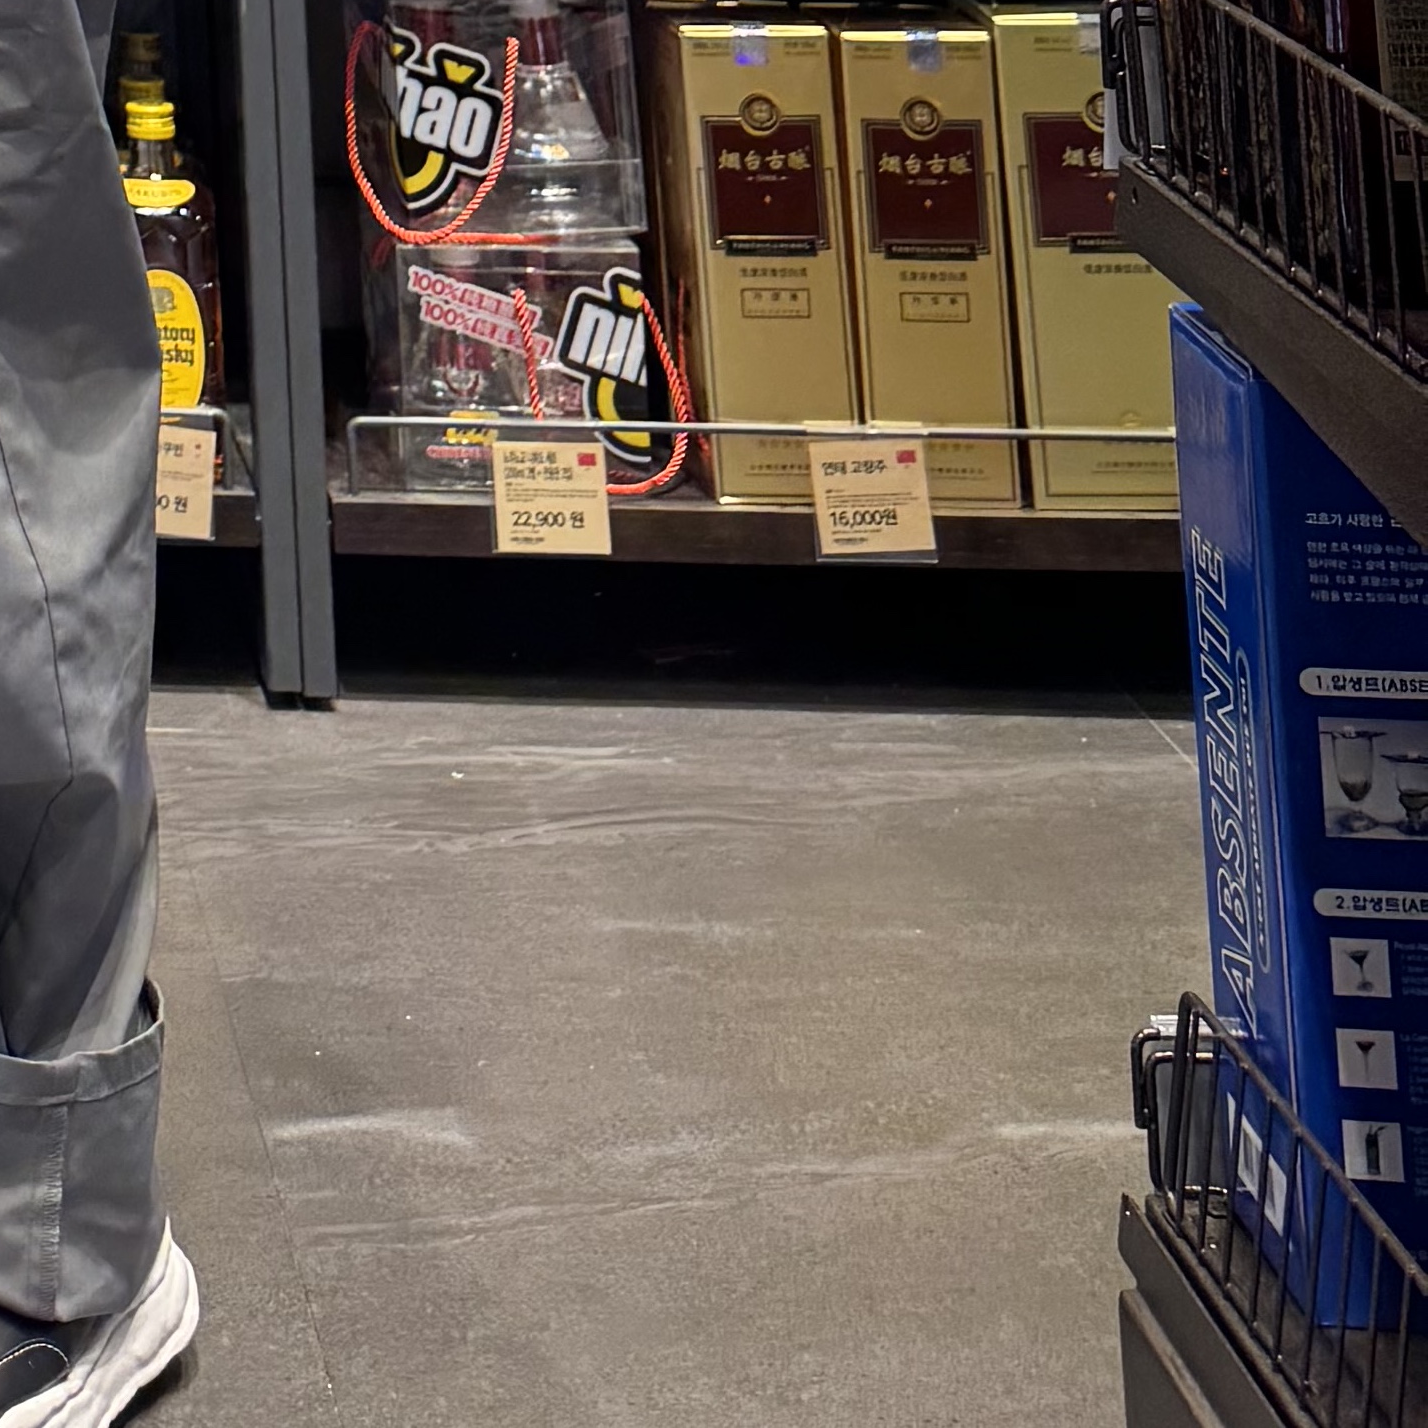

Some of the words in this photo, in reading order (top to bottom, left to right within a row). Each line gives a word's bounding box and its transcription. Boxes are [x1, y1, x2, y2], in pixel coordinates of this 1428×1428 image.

[850, 460, 887, 476] 고량주
[511, 511, 565, 529] 22,900
[570, 511, 586, 530] 원
[829, 507, 899, 529] 16,000원
[1190, 525, 1257, 1040] ABSENTE
